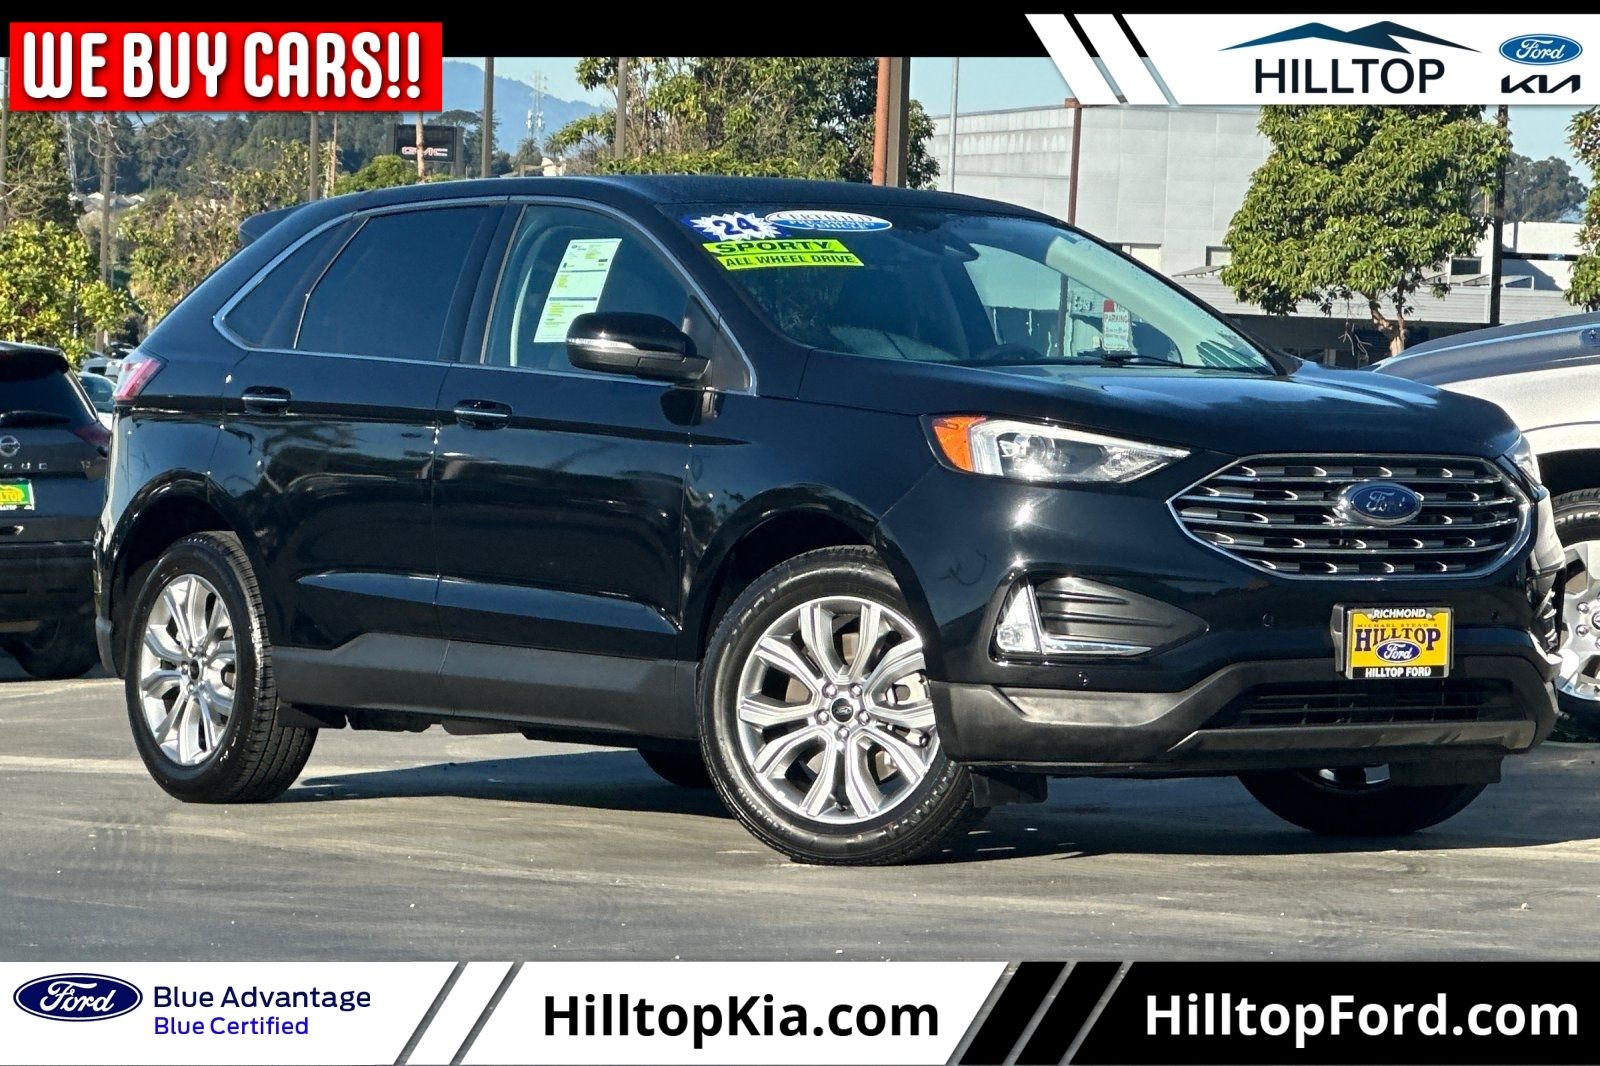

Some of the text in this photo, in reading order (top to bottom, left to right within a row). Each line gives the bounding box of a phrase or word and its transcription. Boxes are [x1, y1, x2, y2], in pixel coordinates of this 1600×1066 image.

[712, 217, 762, 236] 24
[715, 241, 832, 253] SPORTY
[725, 253, 856, 266] ALL WHEEL DRIVE
[1366, 491, 1406, 512] Ford
[1373, 609, 1426, 619] RICHMOND
[1354, 628, 1441, 652] HILLTOP
[1383, 643, 1413, 660] Ford
[1365, 666, 1432, 678] HILLTOP FORD
